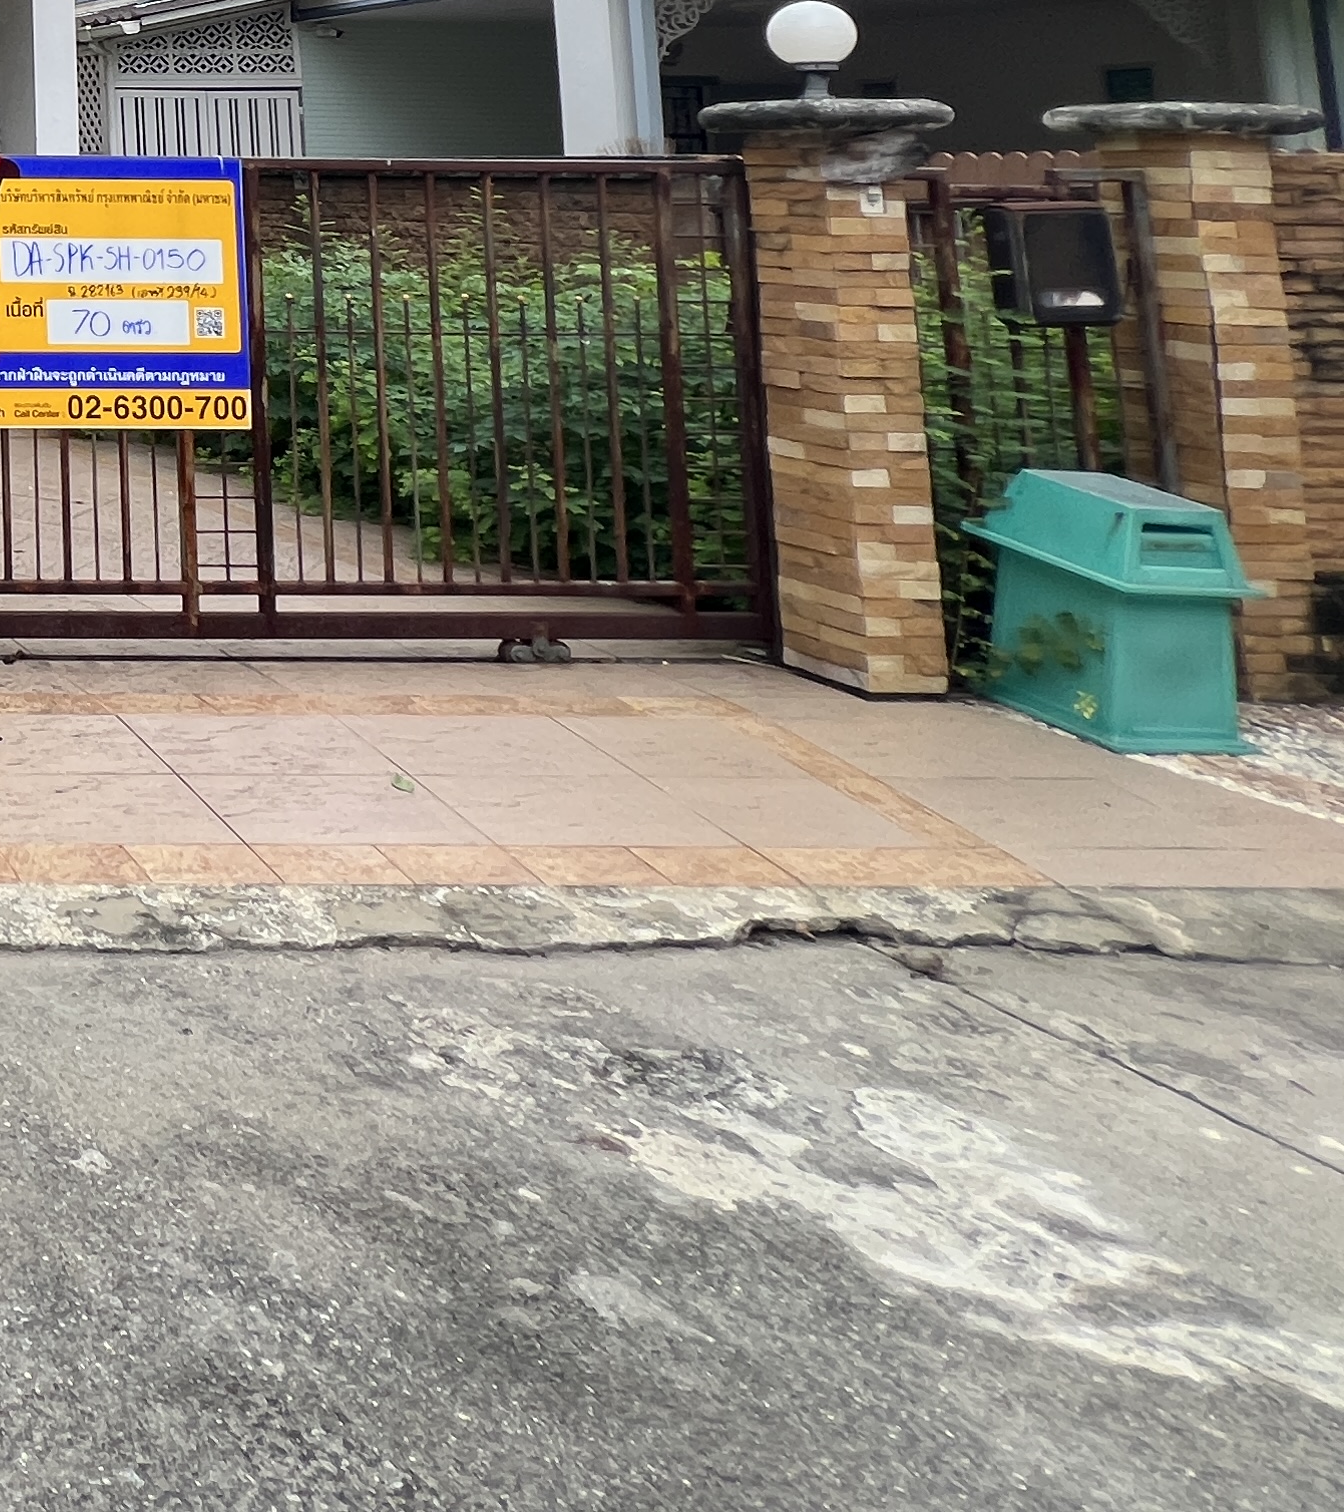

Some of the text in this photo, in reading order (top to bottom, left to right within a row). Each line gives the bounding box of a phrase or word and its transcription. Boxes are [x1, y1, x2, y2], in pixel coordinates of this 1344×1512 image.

[166, 190, 191, 205] จำกัด
[192, 193, 232, 206] (มหาชน)
[2, 224, 69, 236] รหัสทรัพย์สิน
[12, 240, 206, 277] DA-SPK-SH-0150
[5, 296, 45, 318] เนื้อที่
[72, 308, 111, 337] 70
[66, 394, 249, 420] 02-6300-700
